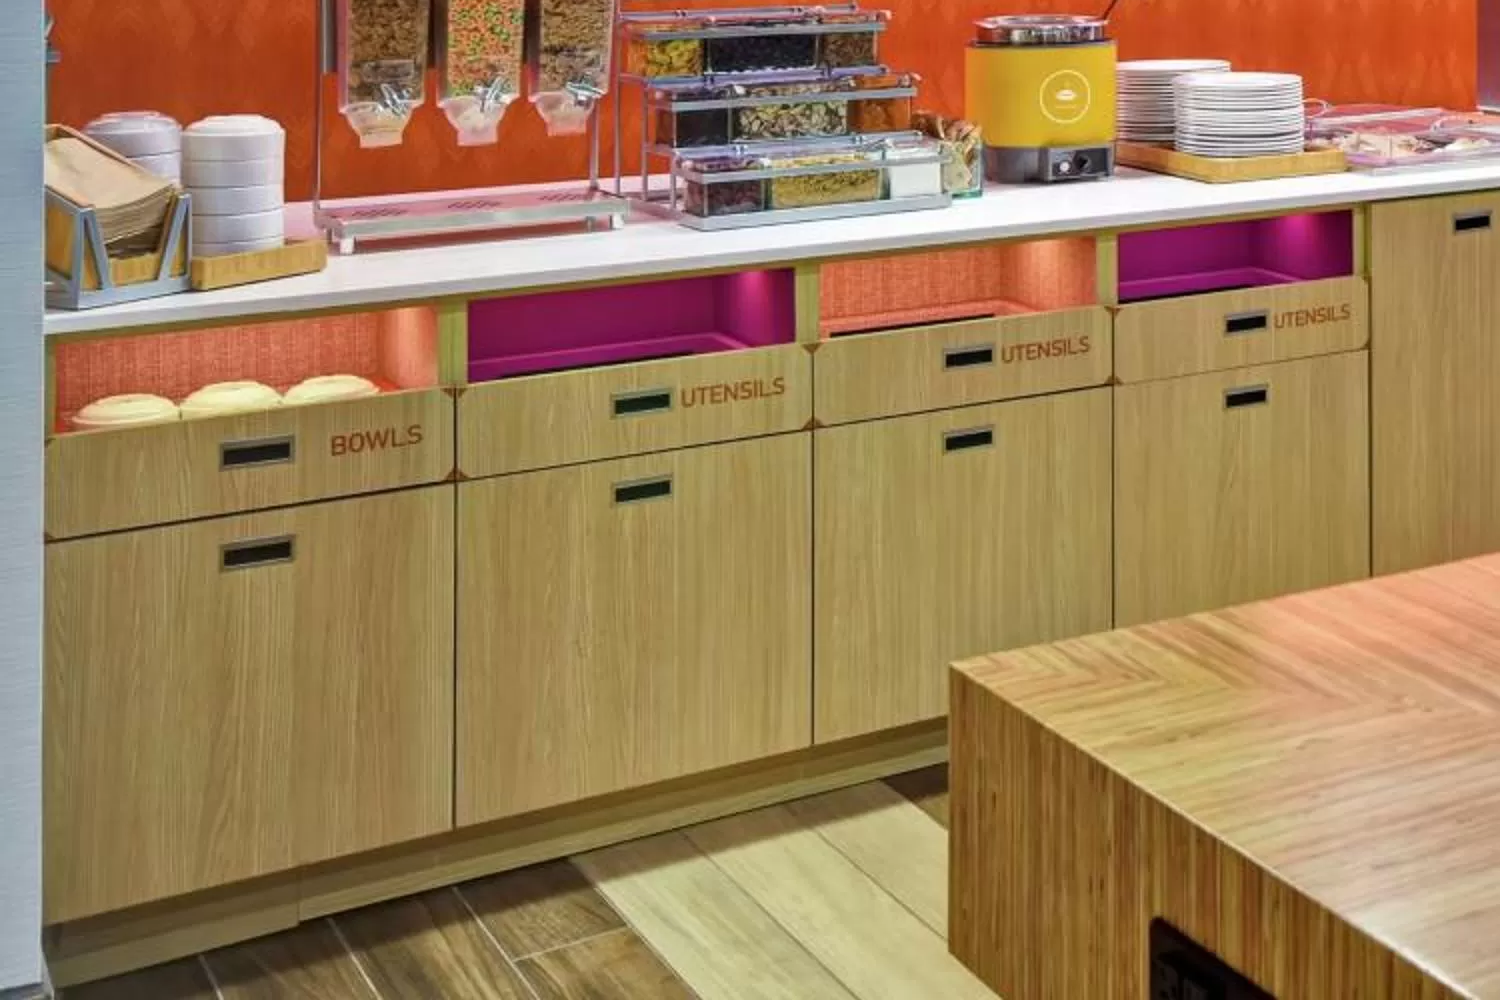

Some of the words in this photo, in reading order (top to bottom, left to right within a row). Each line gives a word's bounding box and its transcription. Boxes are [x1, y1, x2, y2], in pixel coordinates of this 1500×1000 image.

[1274, 303, 1350, 329] UTENSILS
[1001, 335, 1090, 364] UTENSILS
[680, 376, 785, 408] UTENSILS
[331, 424, 423, 456] BOWLS
